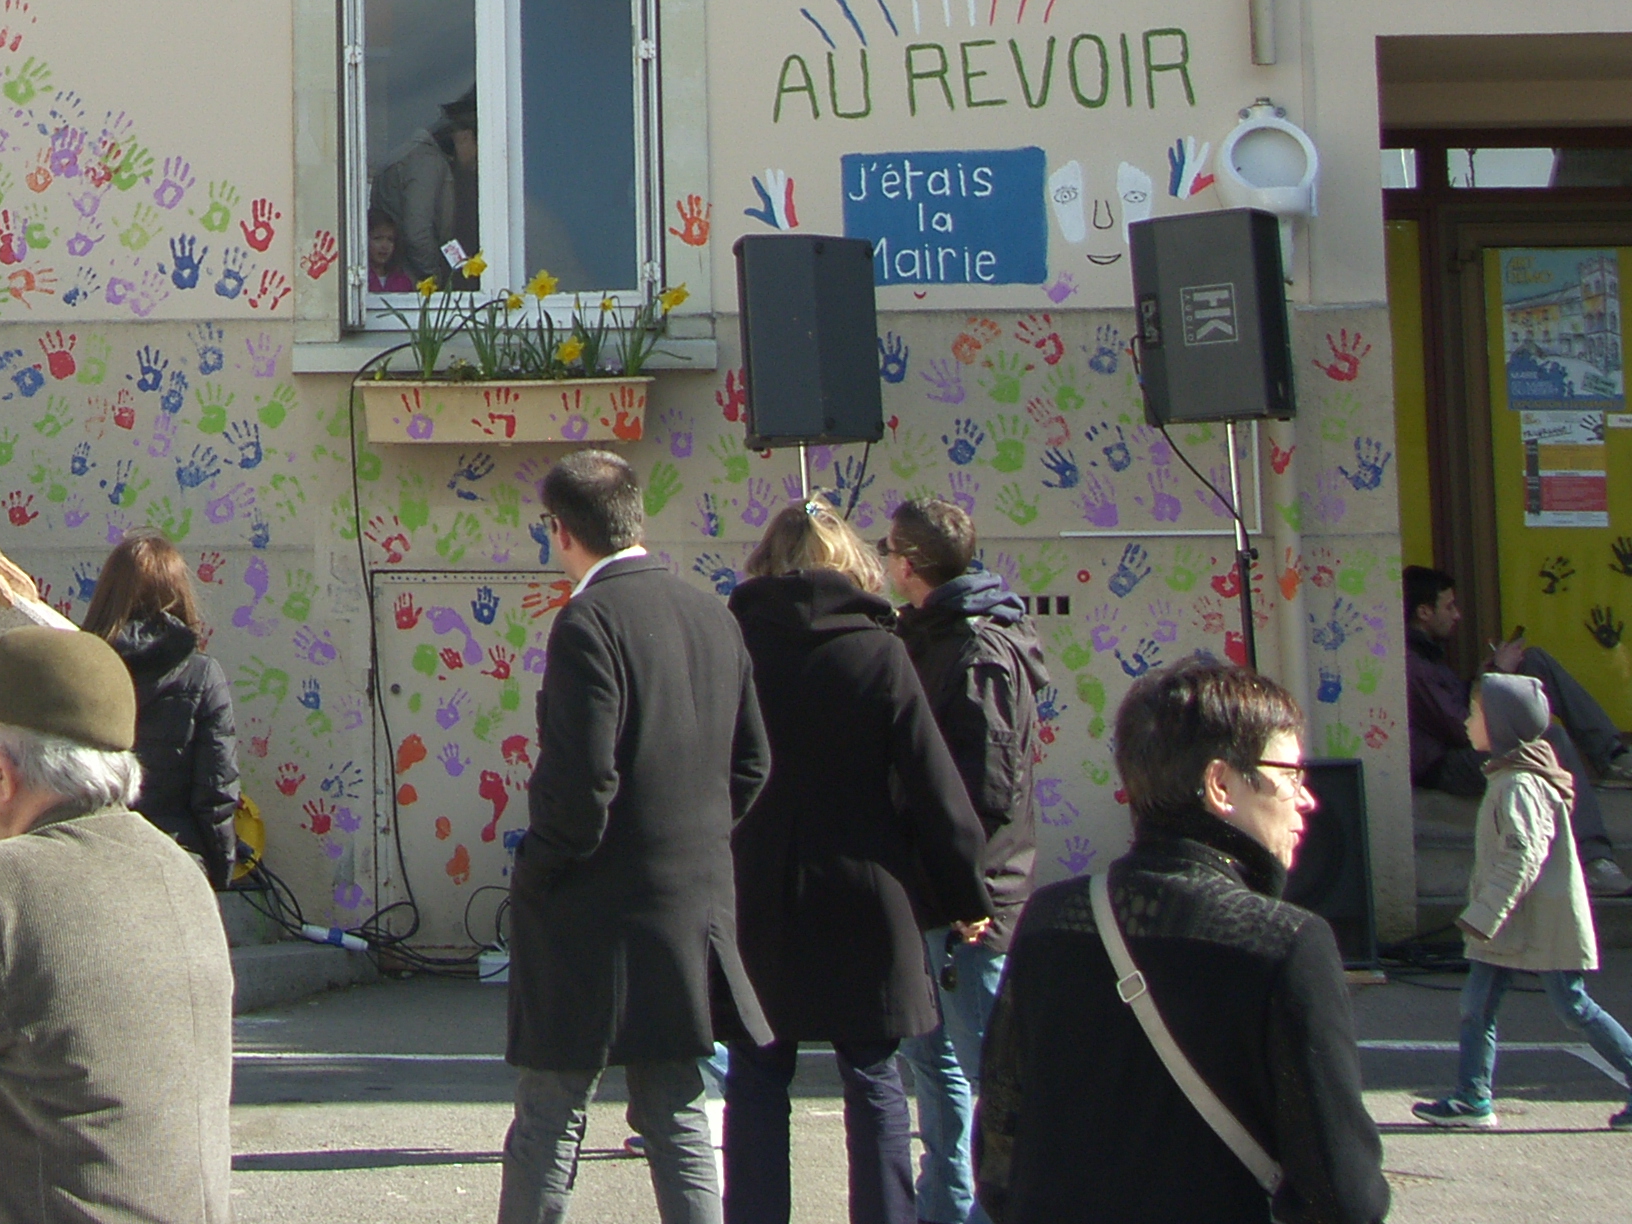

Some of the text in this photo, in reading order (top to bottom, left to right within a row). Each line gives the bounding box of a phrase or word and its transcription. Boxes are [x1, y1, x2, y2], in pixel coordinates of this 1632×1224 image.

[772, 27, 1196, 123] AU REVOIR
[917, 202, 954, 233] la
